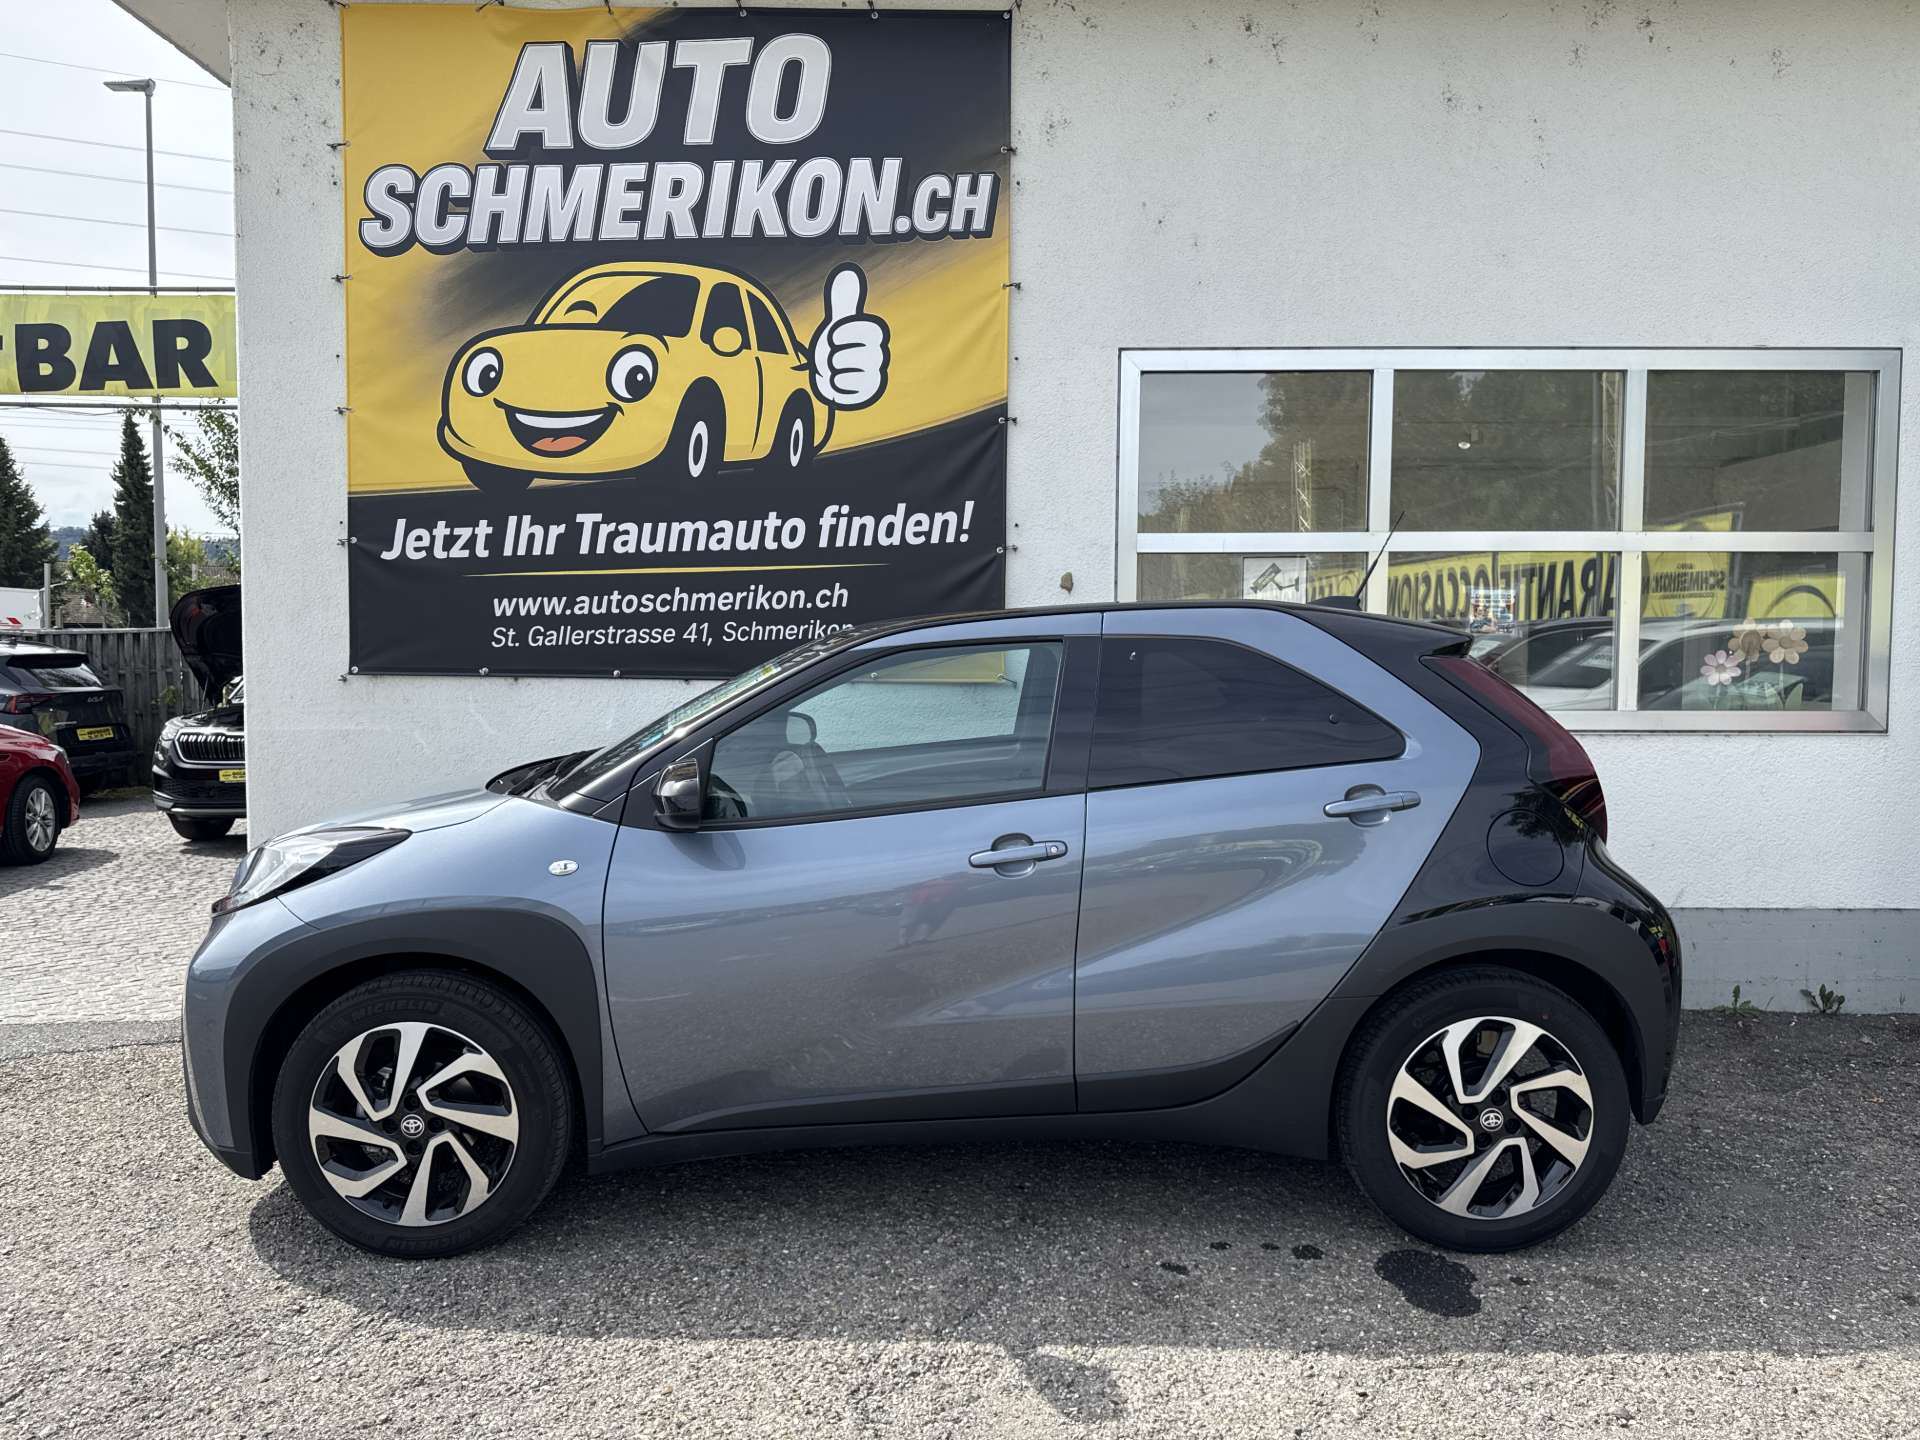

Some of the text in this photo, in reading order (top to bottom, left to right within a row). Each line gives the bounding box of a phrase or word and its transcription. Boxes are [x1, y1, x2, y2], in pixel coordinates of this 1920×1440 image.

[485, 33, 832, 152] AUTO
[359, 156, 997, 250] SCHMERIKON.CH
[0, 319, 219, 392] BAR
[381, 501, 975, 560] Jetzt Ihr Traumauto finden!
[493, 583, 849, 617] www.autoschmerikon.ch
[491, 627, 520, 648] St.
[529, 625, 676, 646] Gallerstrasse
[683, 622, 713, 646] 41,
